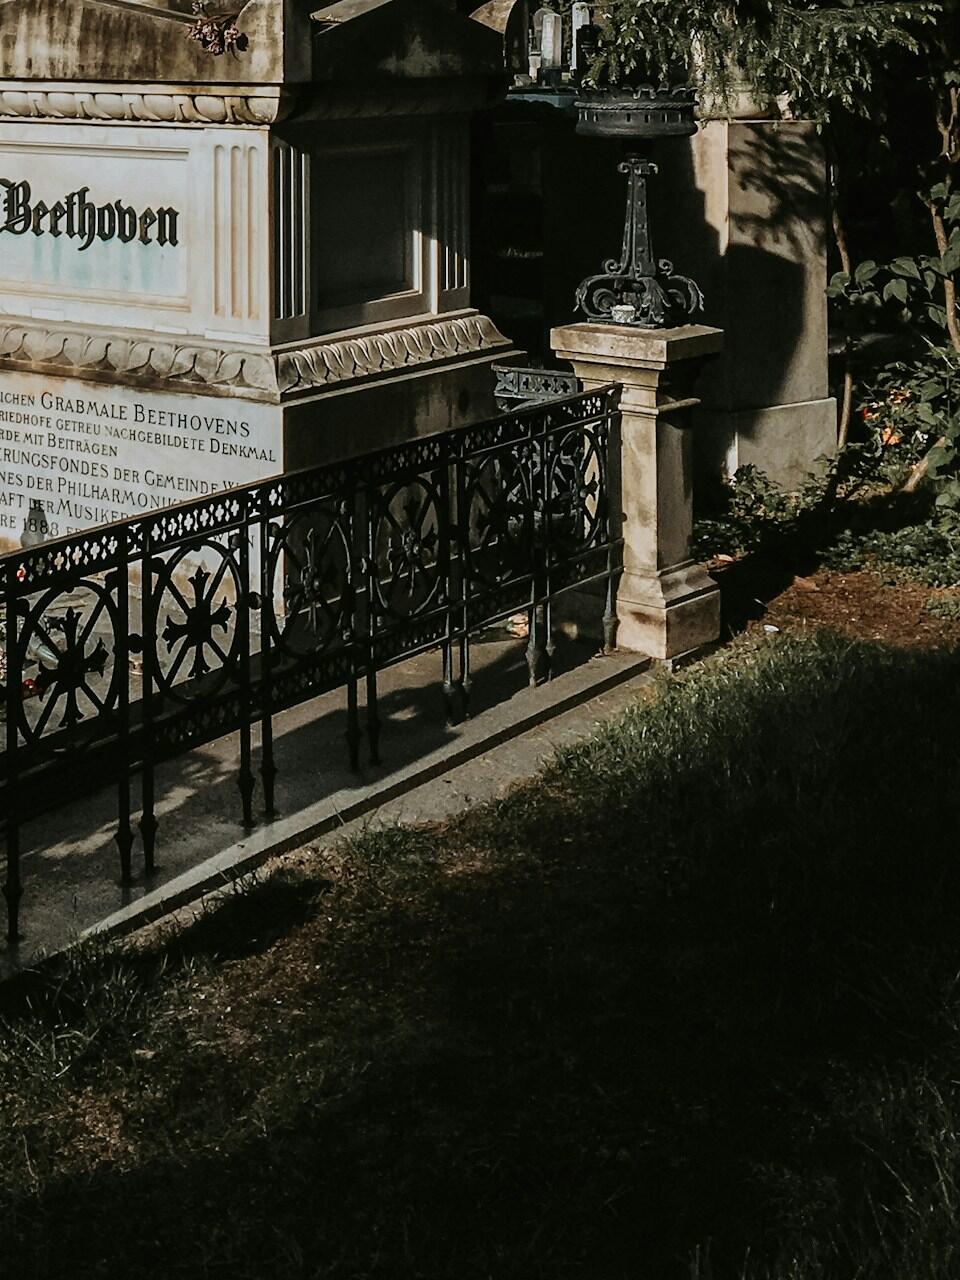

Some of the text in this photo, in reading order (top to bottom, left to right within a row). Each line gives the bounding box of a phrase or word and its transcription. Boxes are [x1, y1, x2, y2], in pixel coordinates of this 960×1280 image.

[41, 391, 127, 421] GRABMALE
[134, 403, 250, 438] BEETHOVENS
[24, 432, 45, 446] MIT
[56, 418, 100, 436] GETREU
[105, 425, 205, 452] NACHGEBILDETE
[210, 438, 277, 463] DENKMAL
[27, 475, 53, 492] DER
[114, 467, 140, 483] DER
[24, 517, 59, 537] 1888
